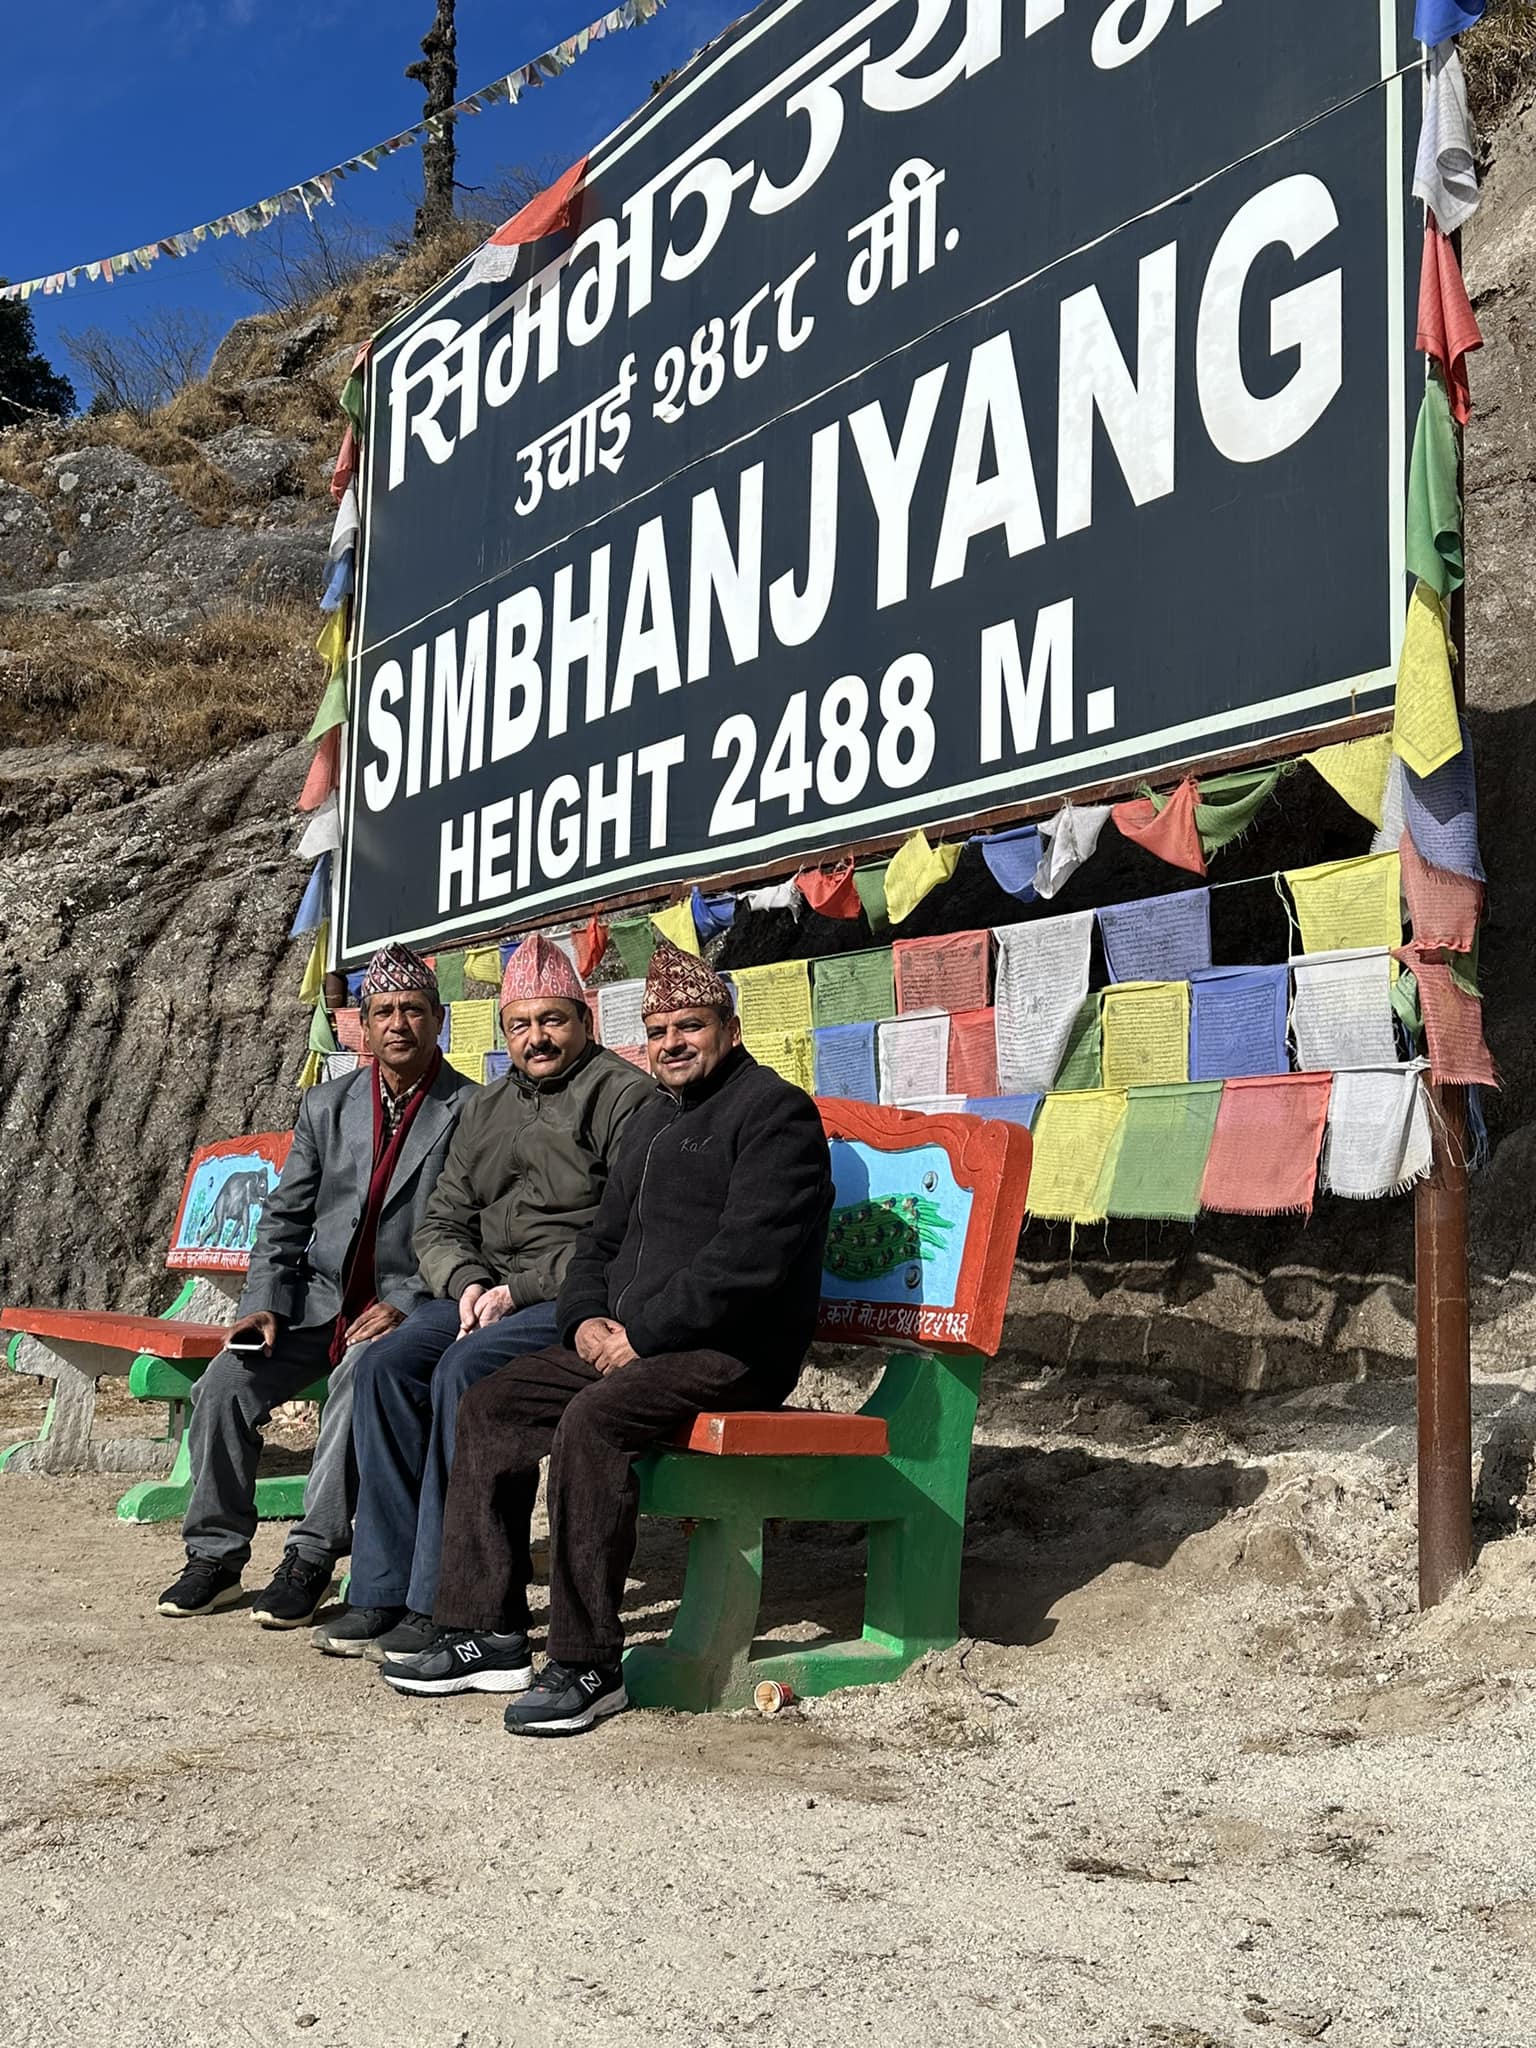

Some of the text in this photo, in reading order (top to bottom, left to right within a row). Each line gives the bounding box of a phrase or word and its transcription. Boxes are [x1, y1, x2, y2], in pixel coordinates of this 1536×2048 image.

[364, 174, 1342, 812] SIMBHANJYANG
[515, 158, 960, 516] उचाई २४८८ मी.
[438, 598, 1115, 913] HEIGHT 2488 M.
[454, 1639, 483, 1664] N
[579, 1669, 602, 1694] N
